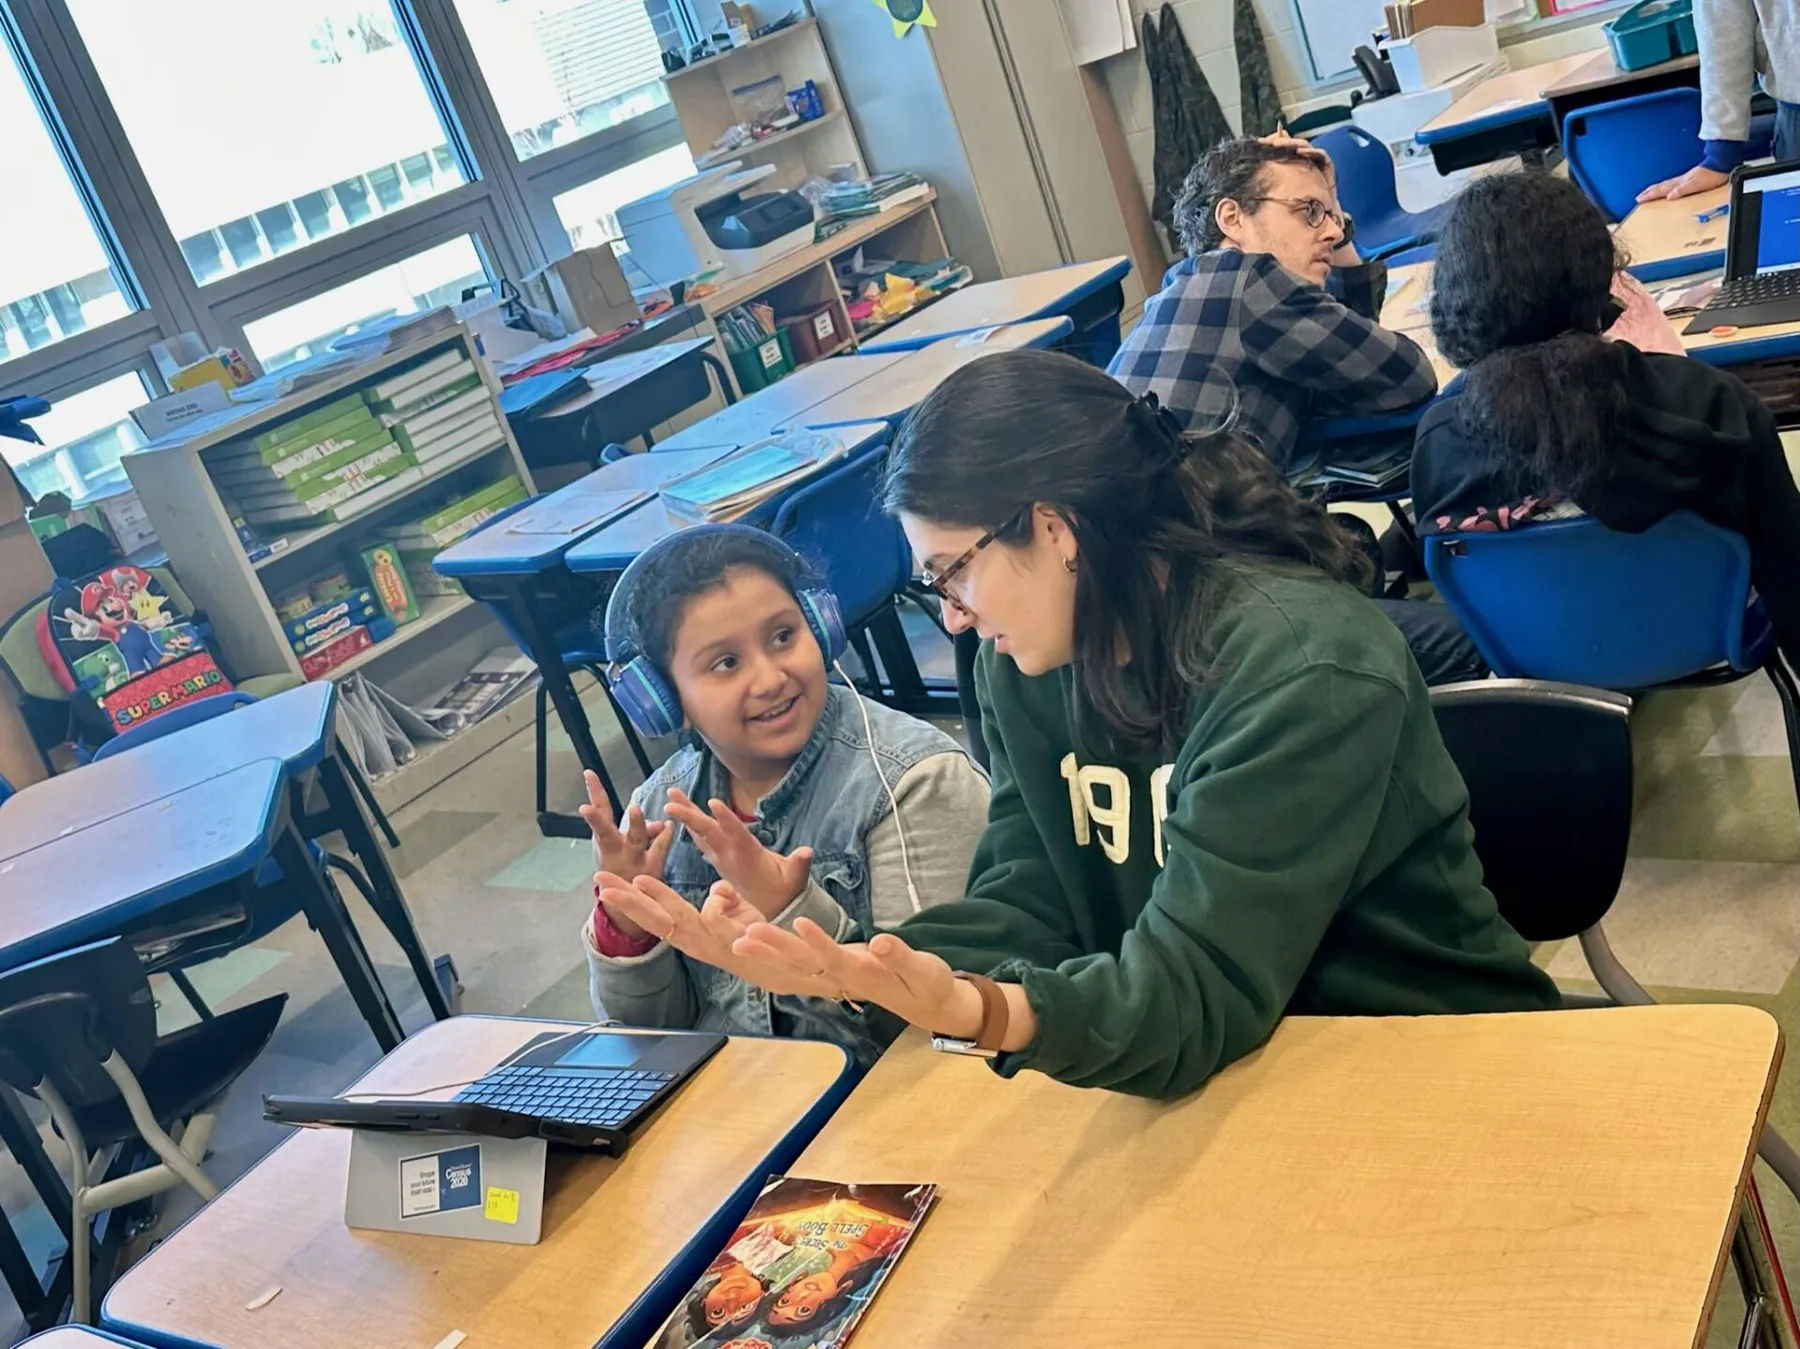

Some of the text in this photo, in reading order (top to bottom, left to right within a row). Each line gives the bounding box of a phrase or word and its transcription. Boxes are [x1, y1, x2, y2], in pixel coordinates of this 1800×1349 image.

[116, 669, 221, 724] SUPER MARIO
[445, 1167, 472, 1181] Census
[450, 1176, 469, 1189] 2020
[831, 1222, 869, 1237] SPELL
